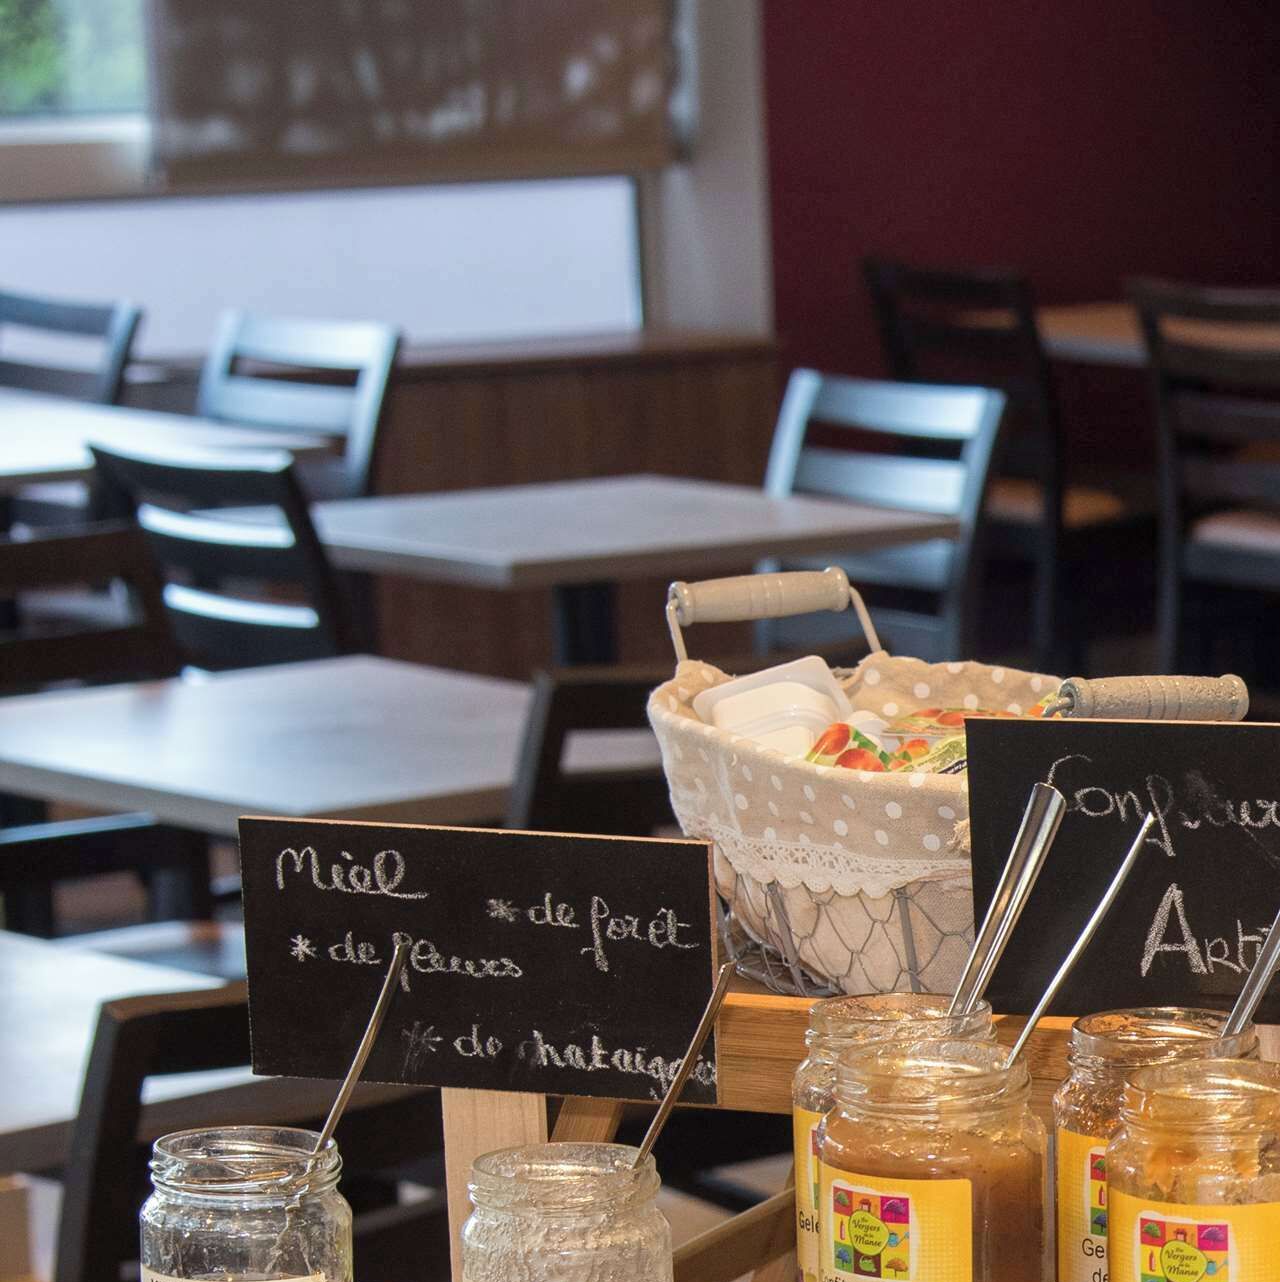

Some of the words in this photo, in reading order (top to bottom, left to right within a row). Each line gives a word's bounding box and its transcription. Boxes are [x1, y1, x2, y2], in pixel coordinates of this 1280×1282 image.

[275, 845, 429, 900] Miel
[526, 892, 580, 929] de
[327, 930, 383, 966] de
